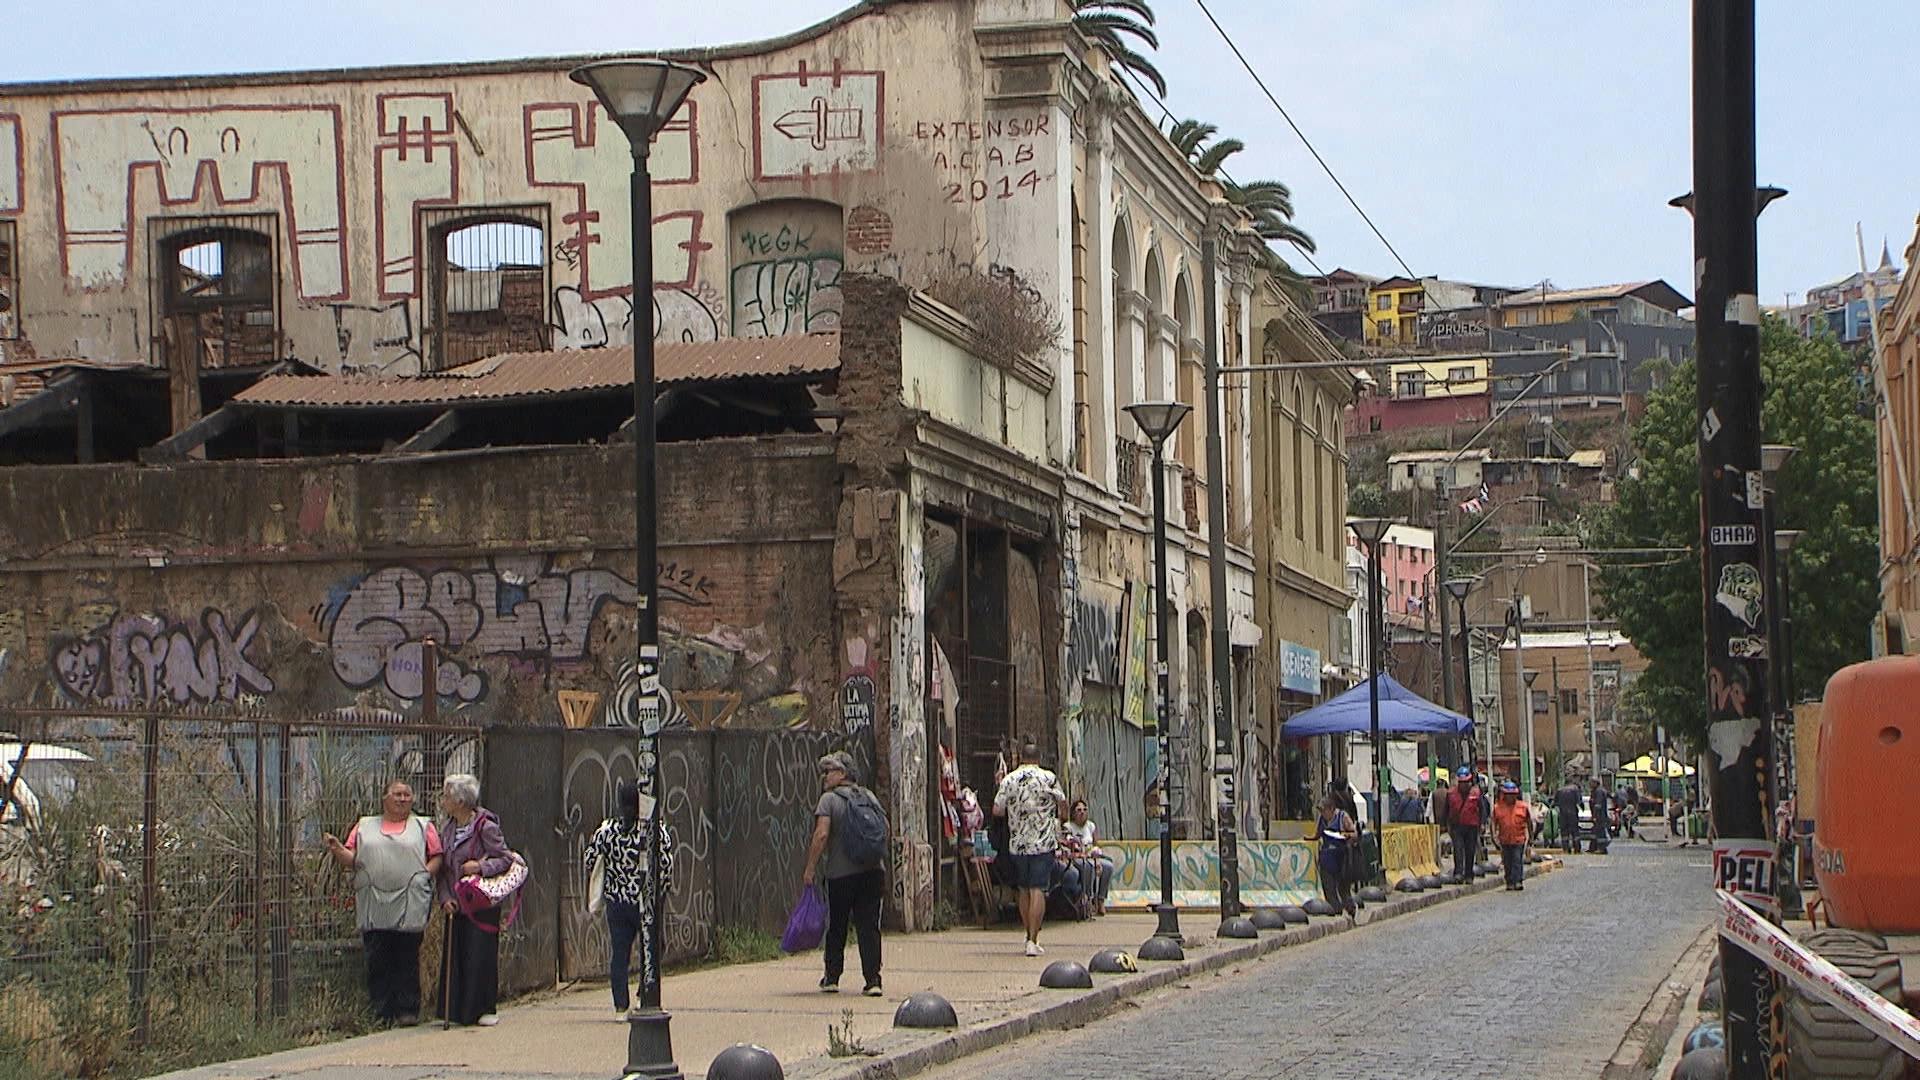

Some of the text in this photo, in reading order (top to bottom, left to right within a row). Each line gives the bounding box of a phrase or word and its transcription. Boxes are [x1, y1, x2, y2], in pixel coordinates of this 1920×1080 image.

[916, 114, 1049, 141] EXTENSOR
[943, 169, 1041, 203] 2014
[846, 687, 860, 703] LA
